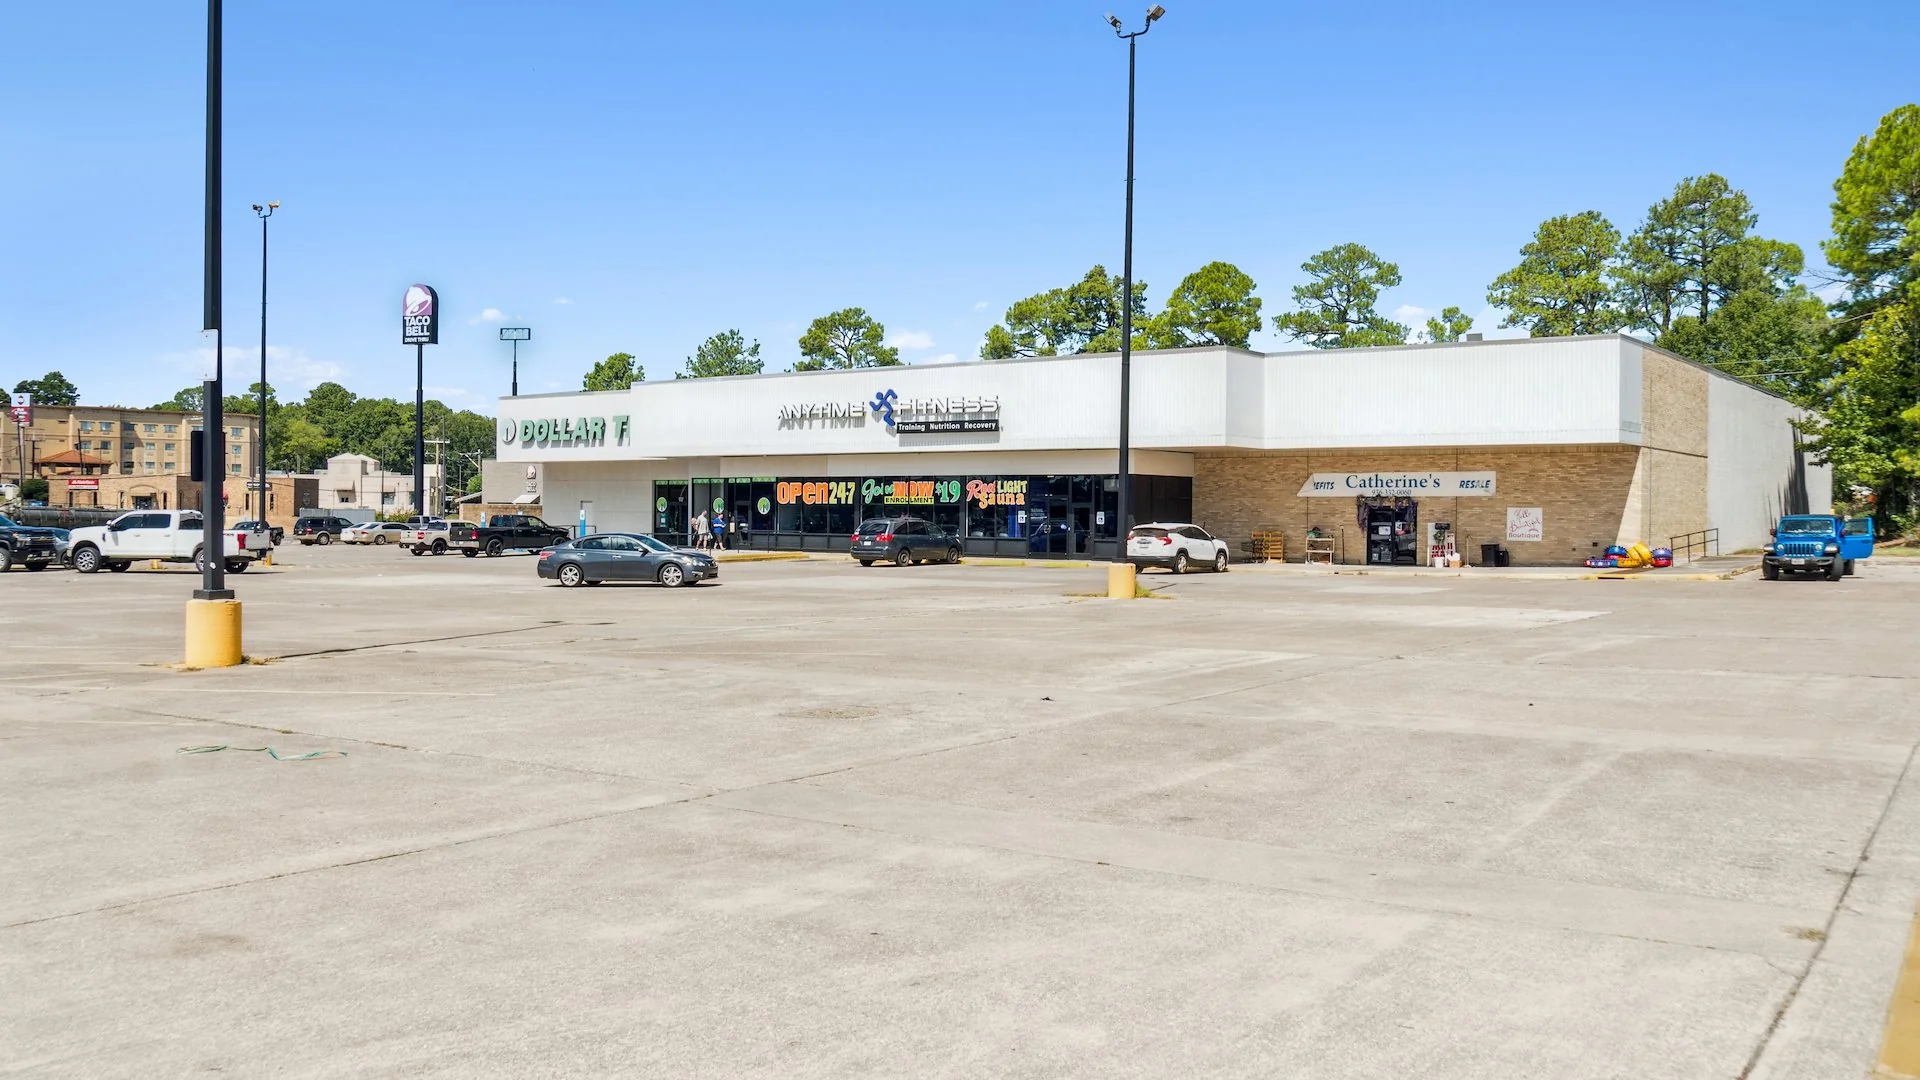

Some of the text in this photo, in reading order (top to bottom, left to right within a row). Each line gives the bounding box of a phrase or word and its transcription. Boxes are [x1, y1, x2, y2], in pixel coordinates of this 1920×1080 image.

[404, 316, 431, 327] TACO
[405, 326, 430, 337] BELL
[777, 394, 999, 419] ANYTIME FITNESS
[519, 417, 605, 442] DOLLAR
[899, 421, 997, 432] Training Nutrition Recovery
[1346, 473, 1441, 489] Catherine's
[1458, 480, 1491, 489] RESALE
[861, 479, 961, 504] Join NOW $19
[966, 479, 1028, 502] Red LIGHT
[885, 496, 934, 504] ENROLLMENT
[978, 492, 1026, 510] Sauna
